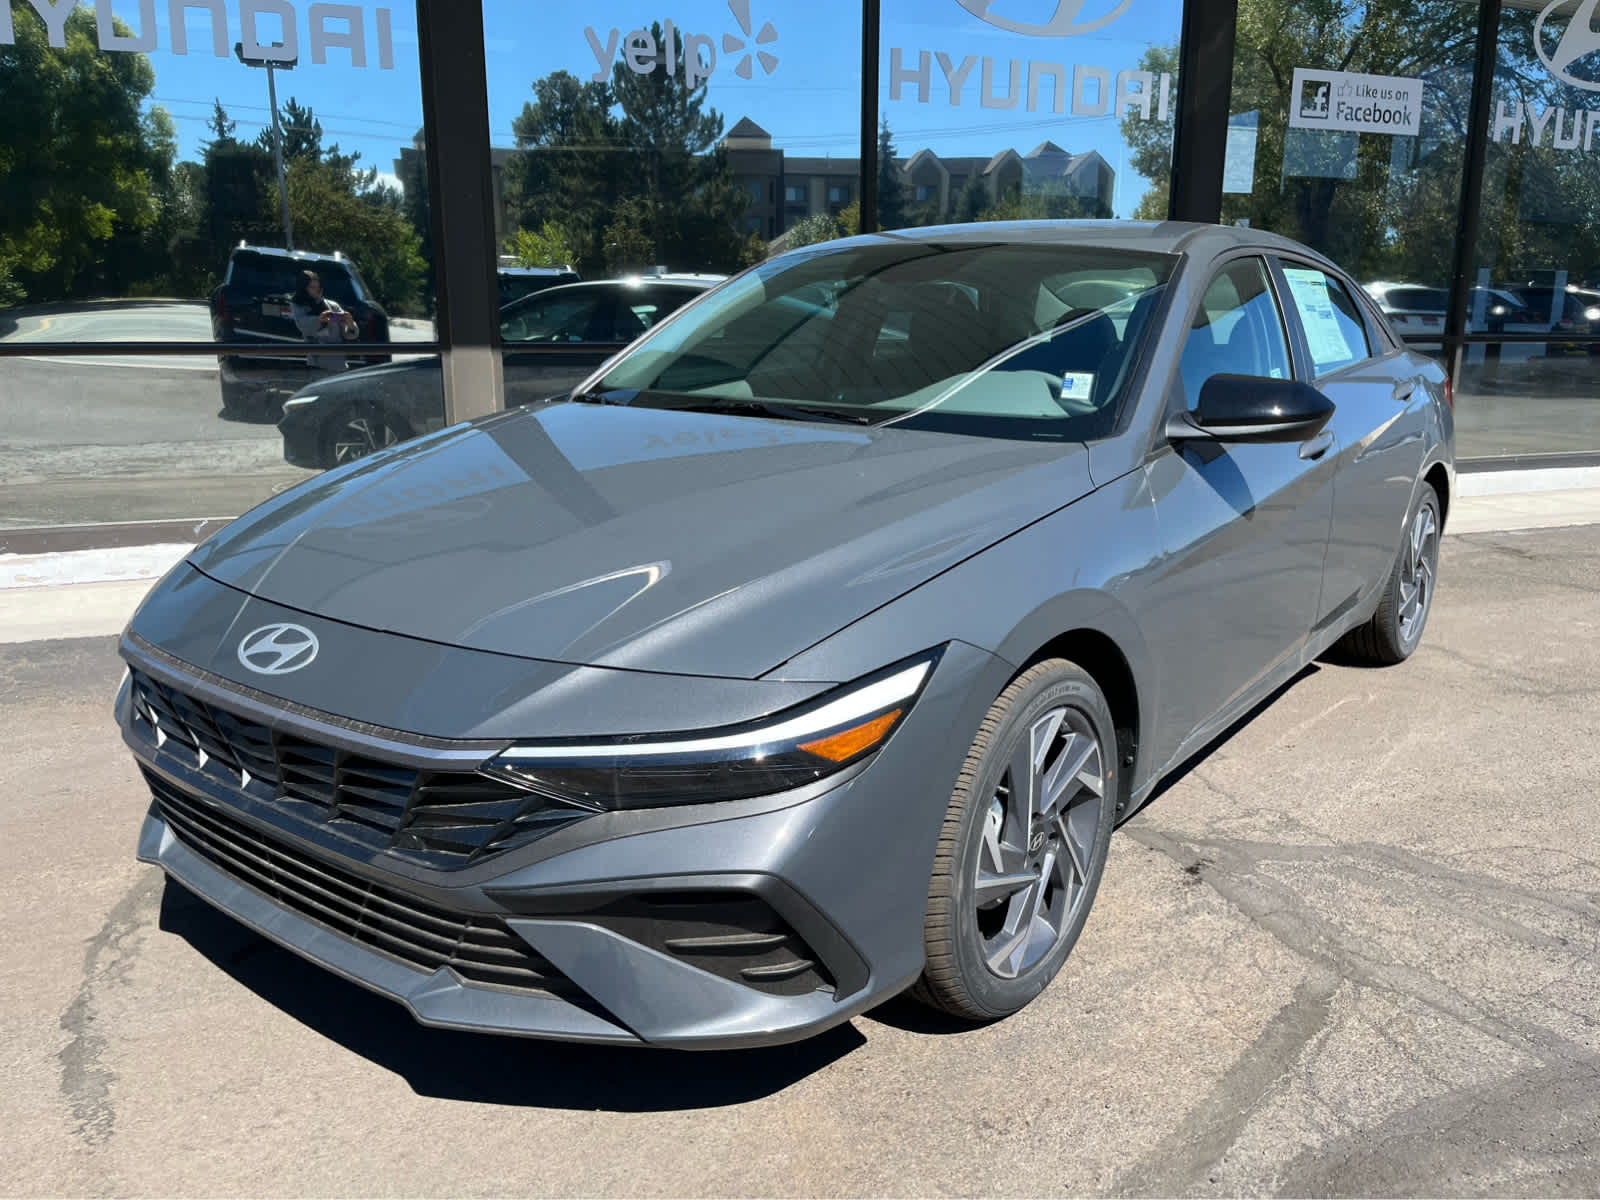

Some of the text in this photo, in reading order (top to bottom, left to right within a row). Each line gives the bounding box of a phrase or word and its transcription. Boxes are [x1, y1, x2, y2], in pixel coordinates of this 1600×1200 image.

[584, 18, 716, 90] yelp
[889, 47, 1170, 121] HYUNDAI
[1355, 84, 1409, 101] Like us on
[1336, 101, 1412, 126] Facebook
